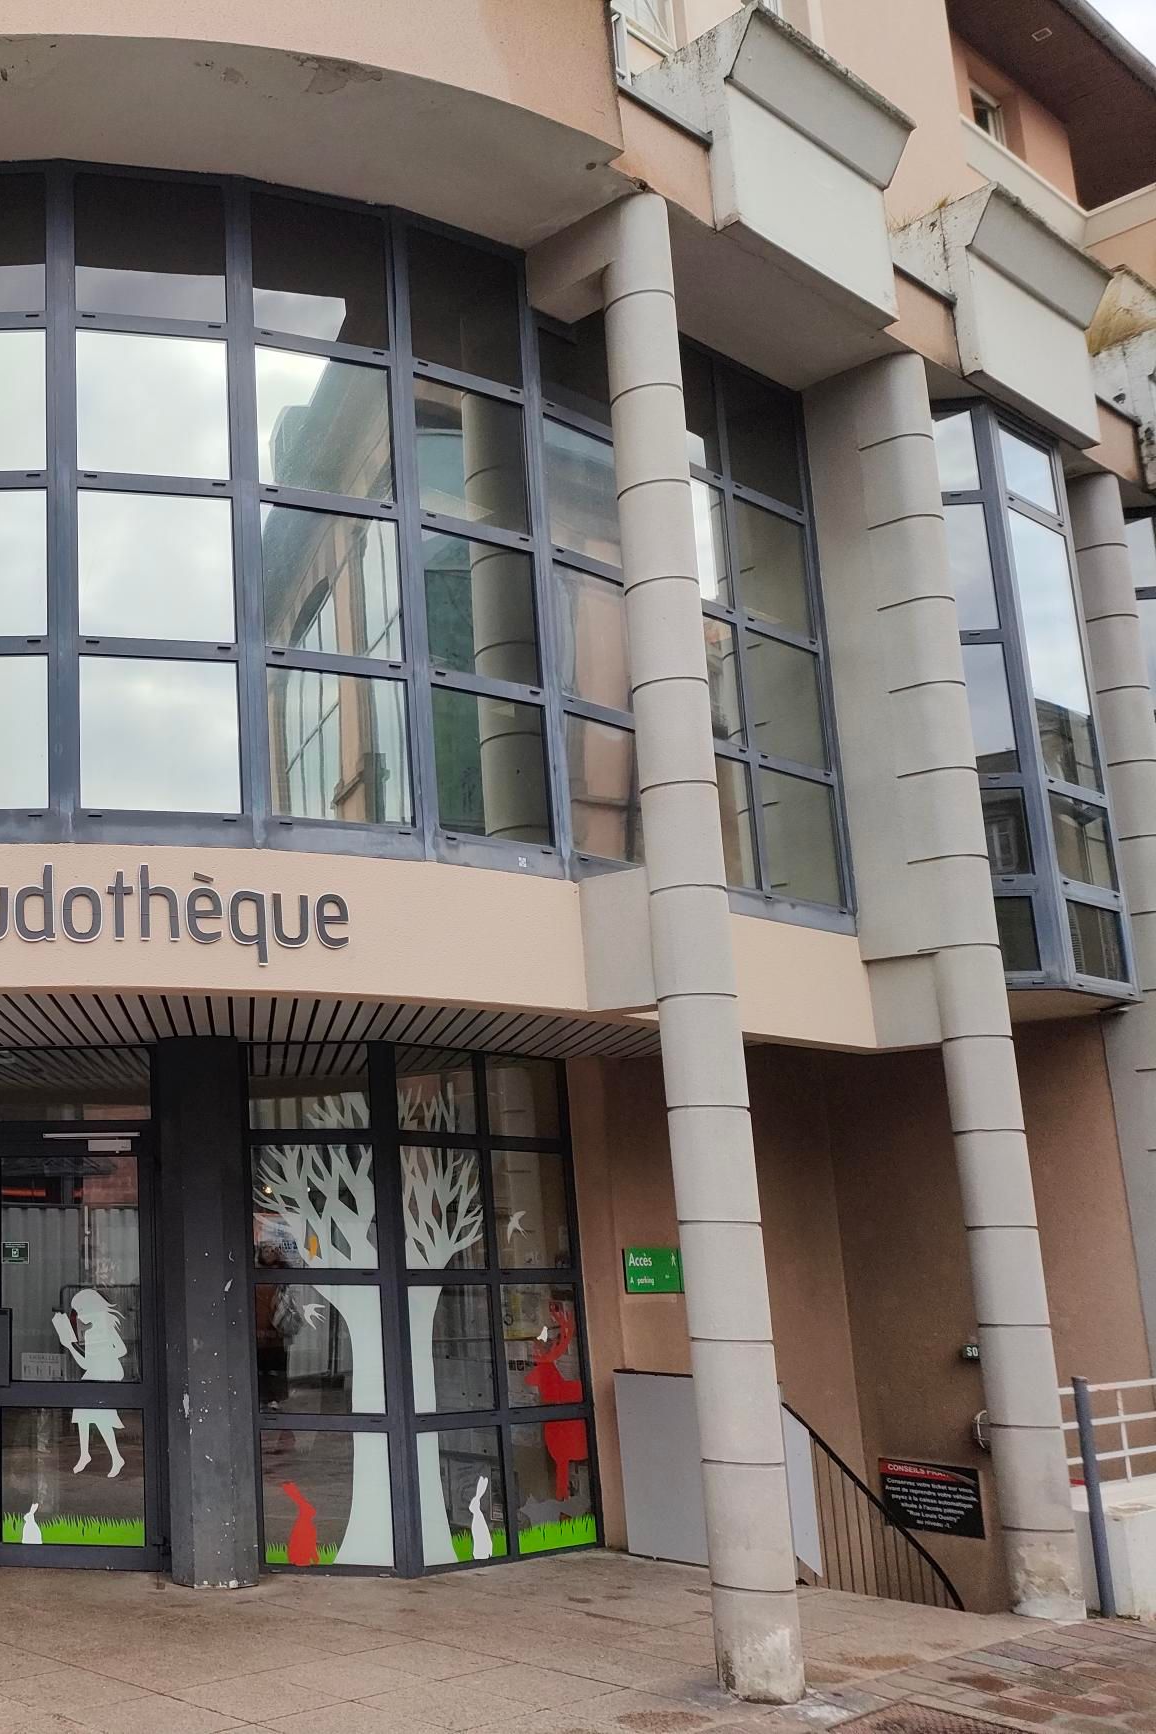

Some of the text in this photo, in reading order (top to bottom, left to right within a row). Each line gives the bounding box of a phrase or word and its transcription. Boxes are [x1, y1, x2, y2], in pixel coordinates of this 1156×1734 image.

[628, 1252, 653, 1267] Accès
[637, 1276, 655, 1287] parking
[887, 1463, 925, 1475] CONSEILS
